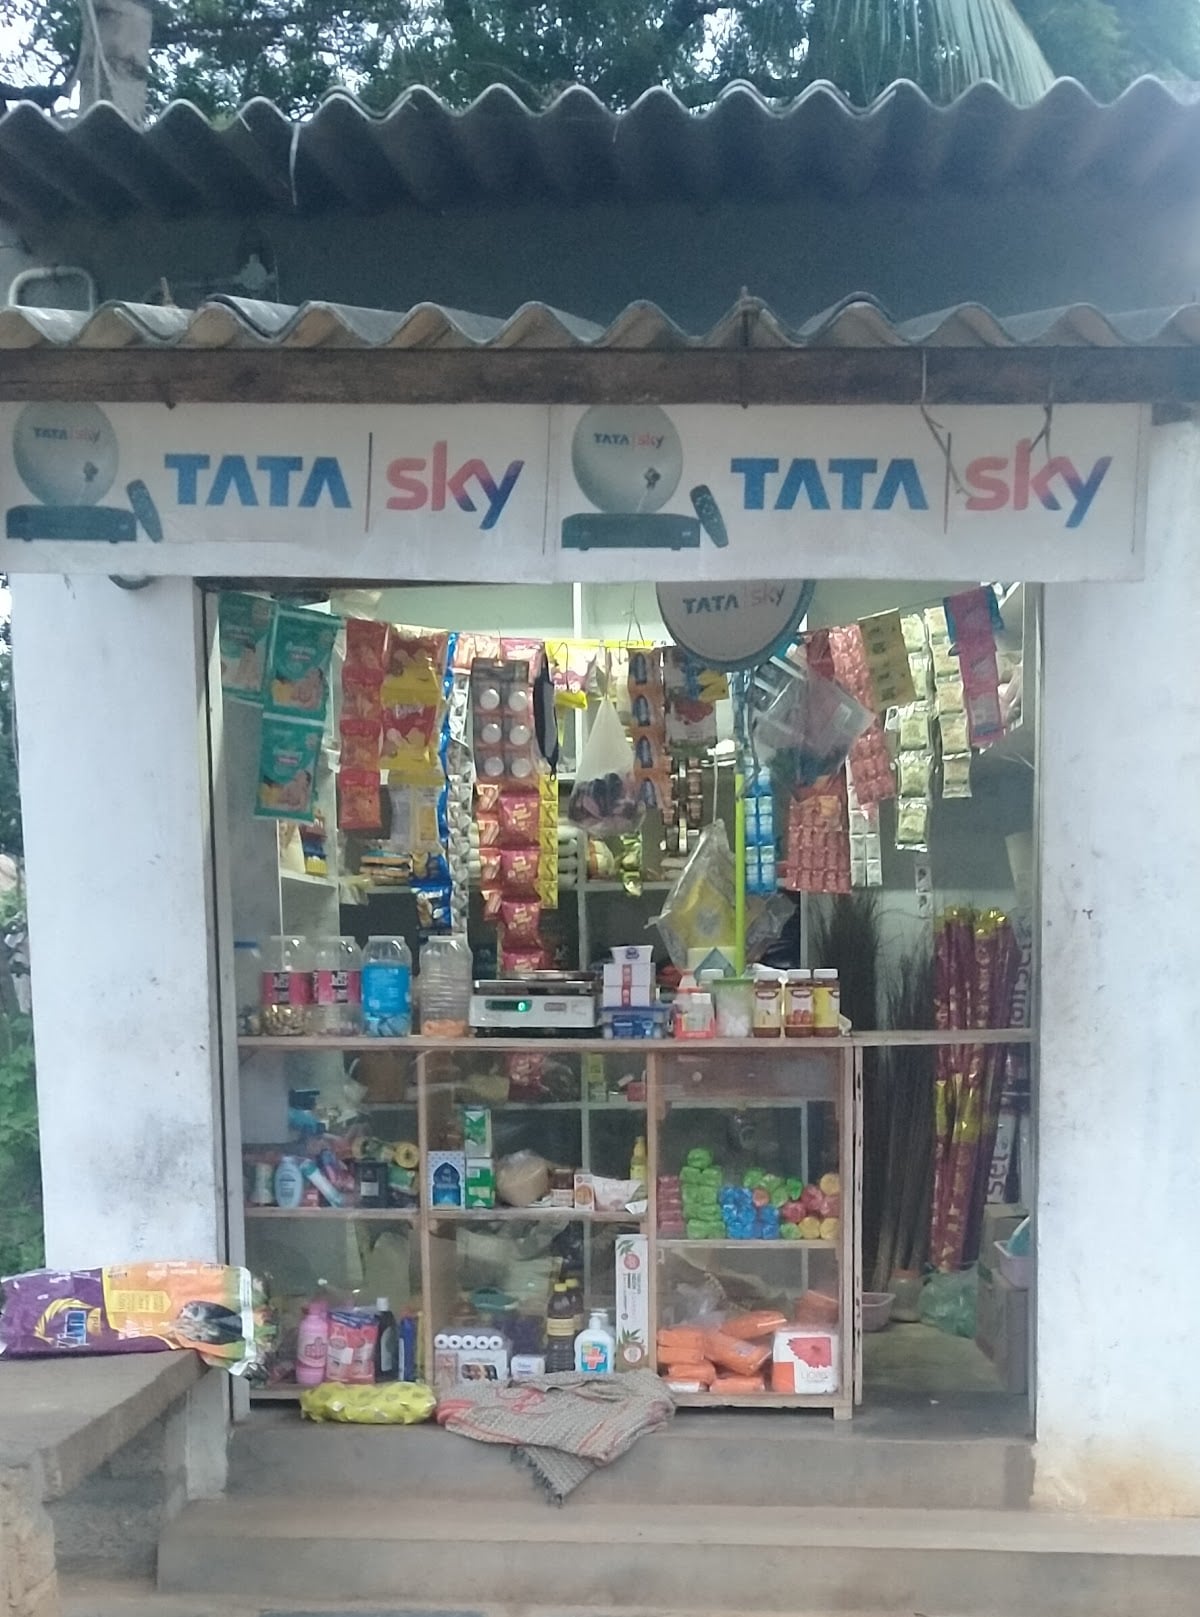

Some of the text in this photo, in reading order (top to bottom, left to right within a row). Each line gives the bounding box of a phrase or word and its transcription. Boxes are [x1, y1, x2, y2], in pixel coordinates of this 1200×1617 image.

[34, 427, 67, 440] TATA
[593, 432, 629, 445] TATA
[164, 440, 524, 530] TATA sky
[730, 440, 1113, 529] TATA sky
[682, 593, 739, 614] TATA
